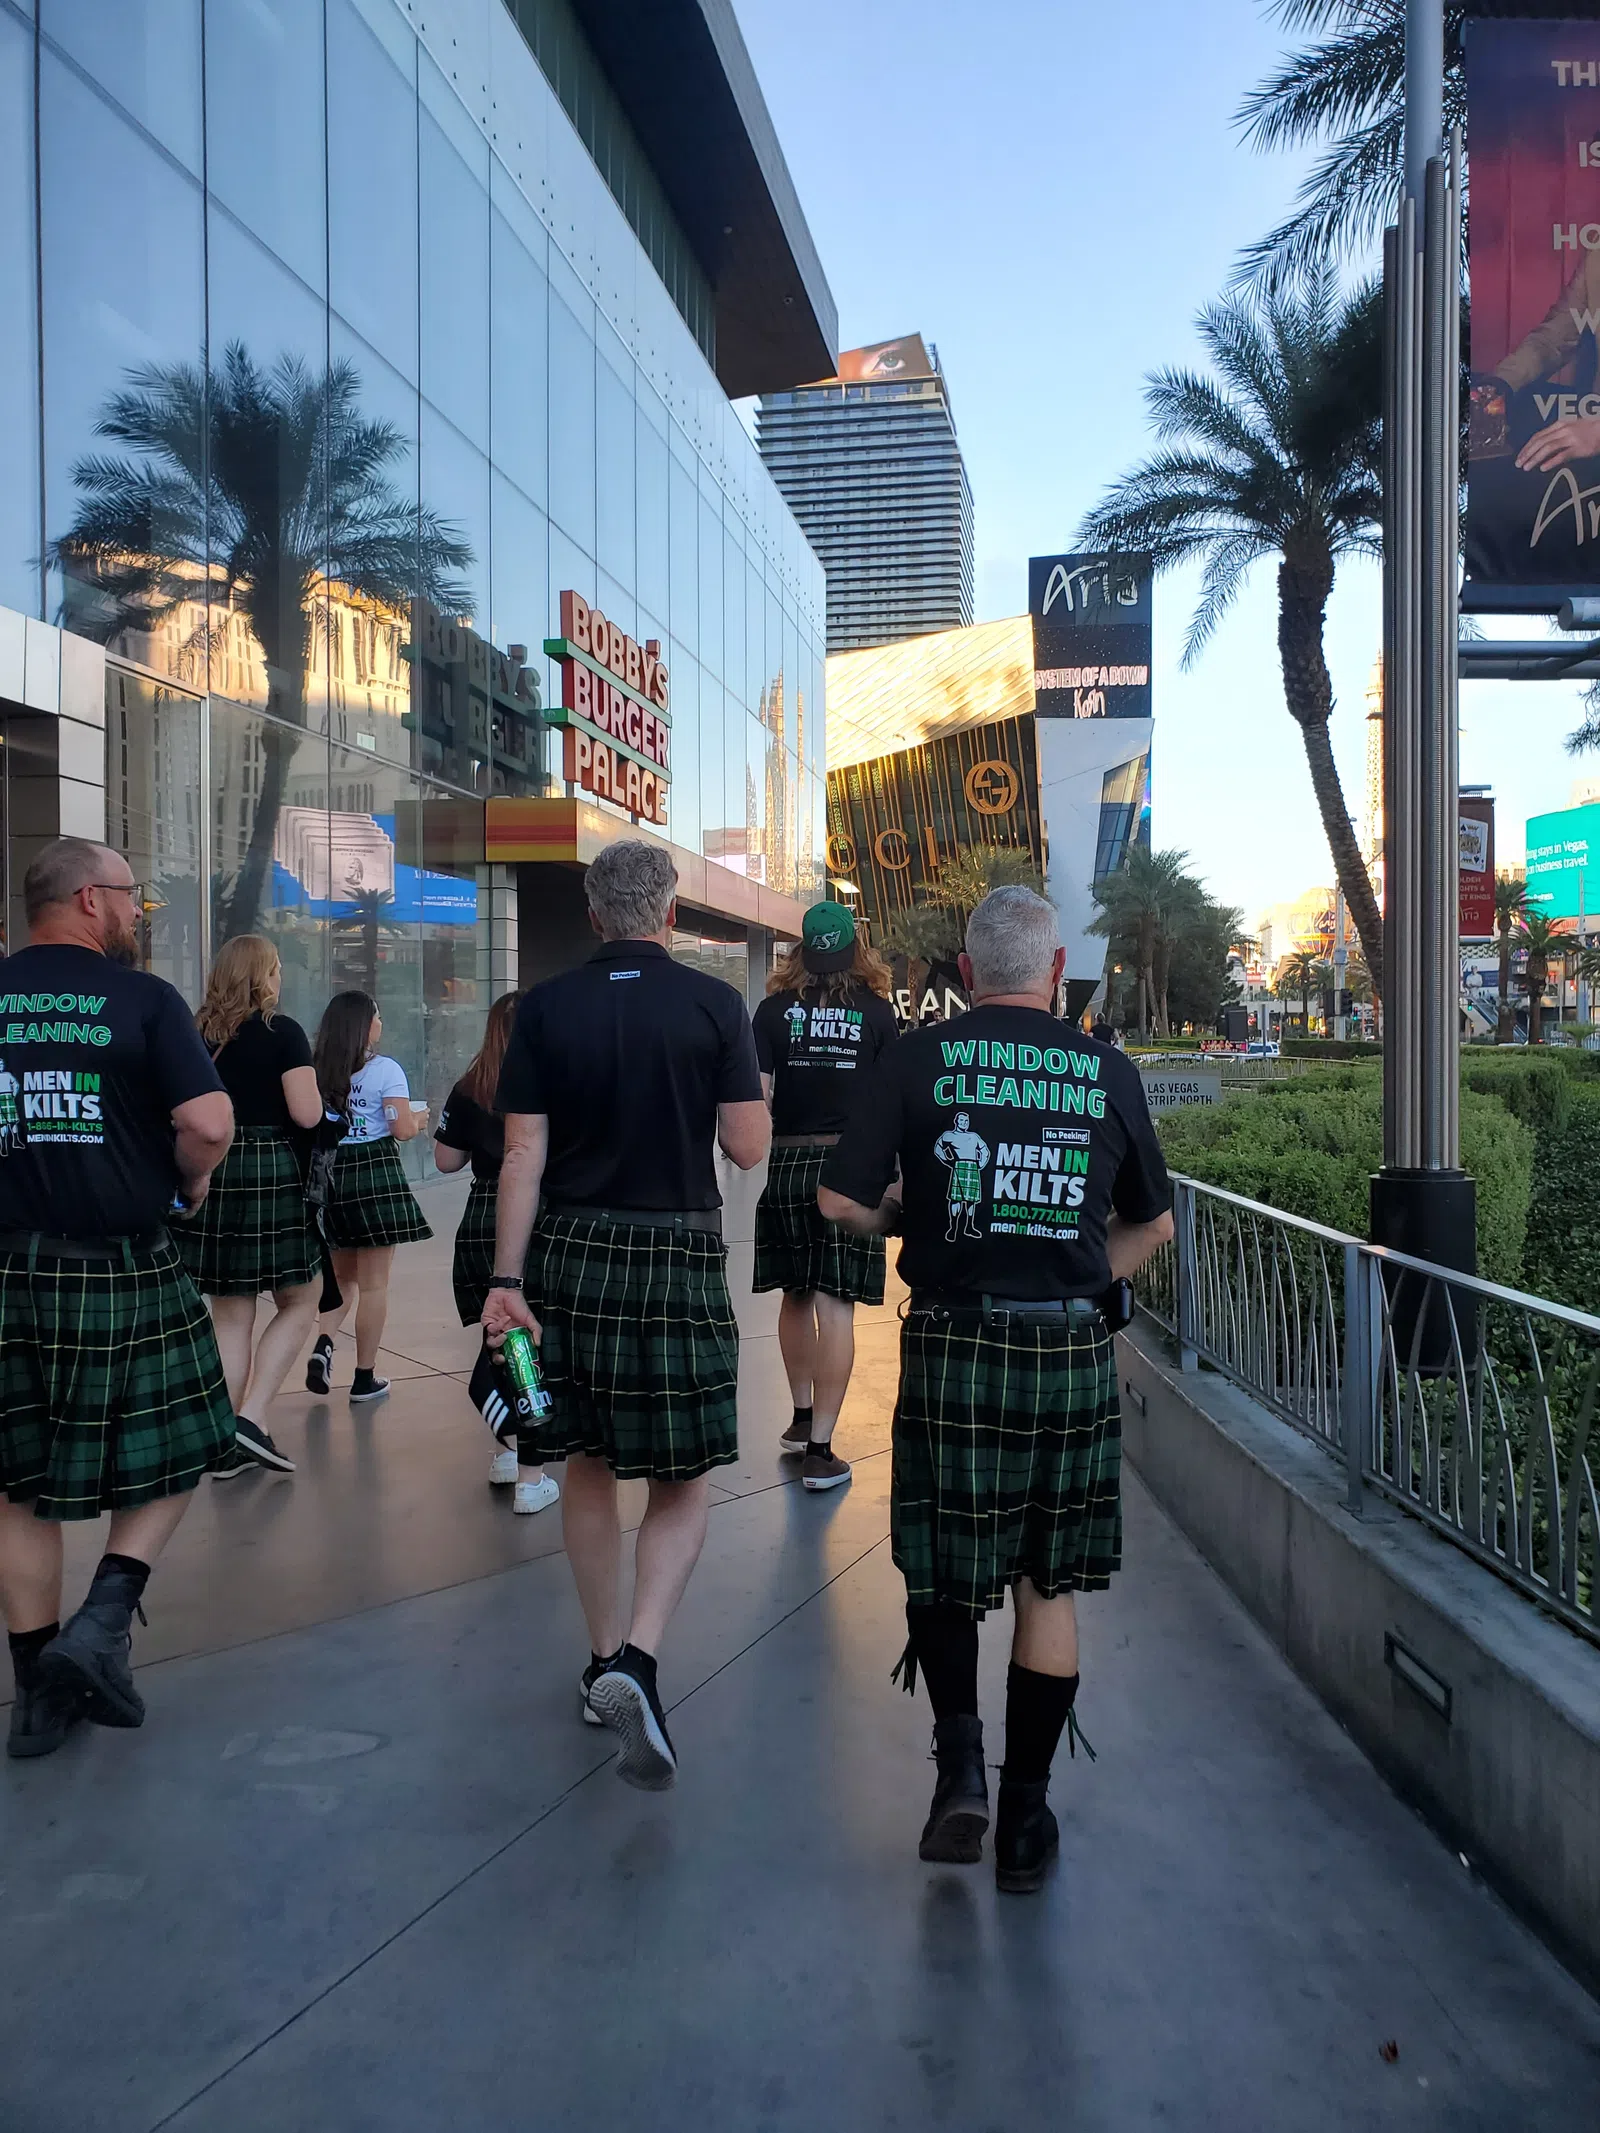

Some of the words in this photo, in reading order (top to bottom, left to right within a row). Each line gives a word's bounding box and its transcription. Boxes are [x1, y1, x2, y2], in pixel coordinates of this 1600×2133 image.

[1551, 61, 1600, 86] TH
[1533, 394, 1600, 422] VEG
[1042, 561, 1138, 616] Aria
[571, 590, 669, 712] BOBBY'S
[1035, 667, 1082, 690] SYSTEM
[1109, 665, 1148, 686] DOWN
[574, 658, 668, 768] BURGER
[575, 727, 668, 824] PALACE
[811, 1007, 846, 1021] MEN
[846, 1009, 863, 1025] IN
[0, 1022, 112, 1046] EANING
[940, 1040, 1101, 1081] WINDOW
[23, 1071, 72, 1091] MEN
[75, 1072, 100, 1092] IN
[1147, 1083, 1165, 1093] LAS
[1168, 1083, 1199, 1093] VEGAS
[933, 1074, 1107, 1119] CLEANING
[1147, 1095, 1176, 1106] STRIP
[1179, 1095, 1212, 1106] NORTH
[1045, 1130, 1057, 1139] No
[1058, 1131, 1088, 1142] Peeking!
[996, 1143, 1061, 1171] MEN
[1063, 1149, 1090, 1175] IN
[993, 1169, 1086, 1206] KILTS
[990, 1221, 1079, 1240] meninkilts.com
